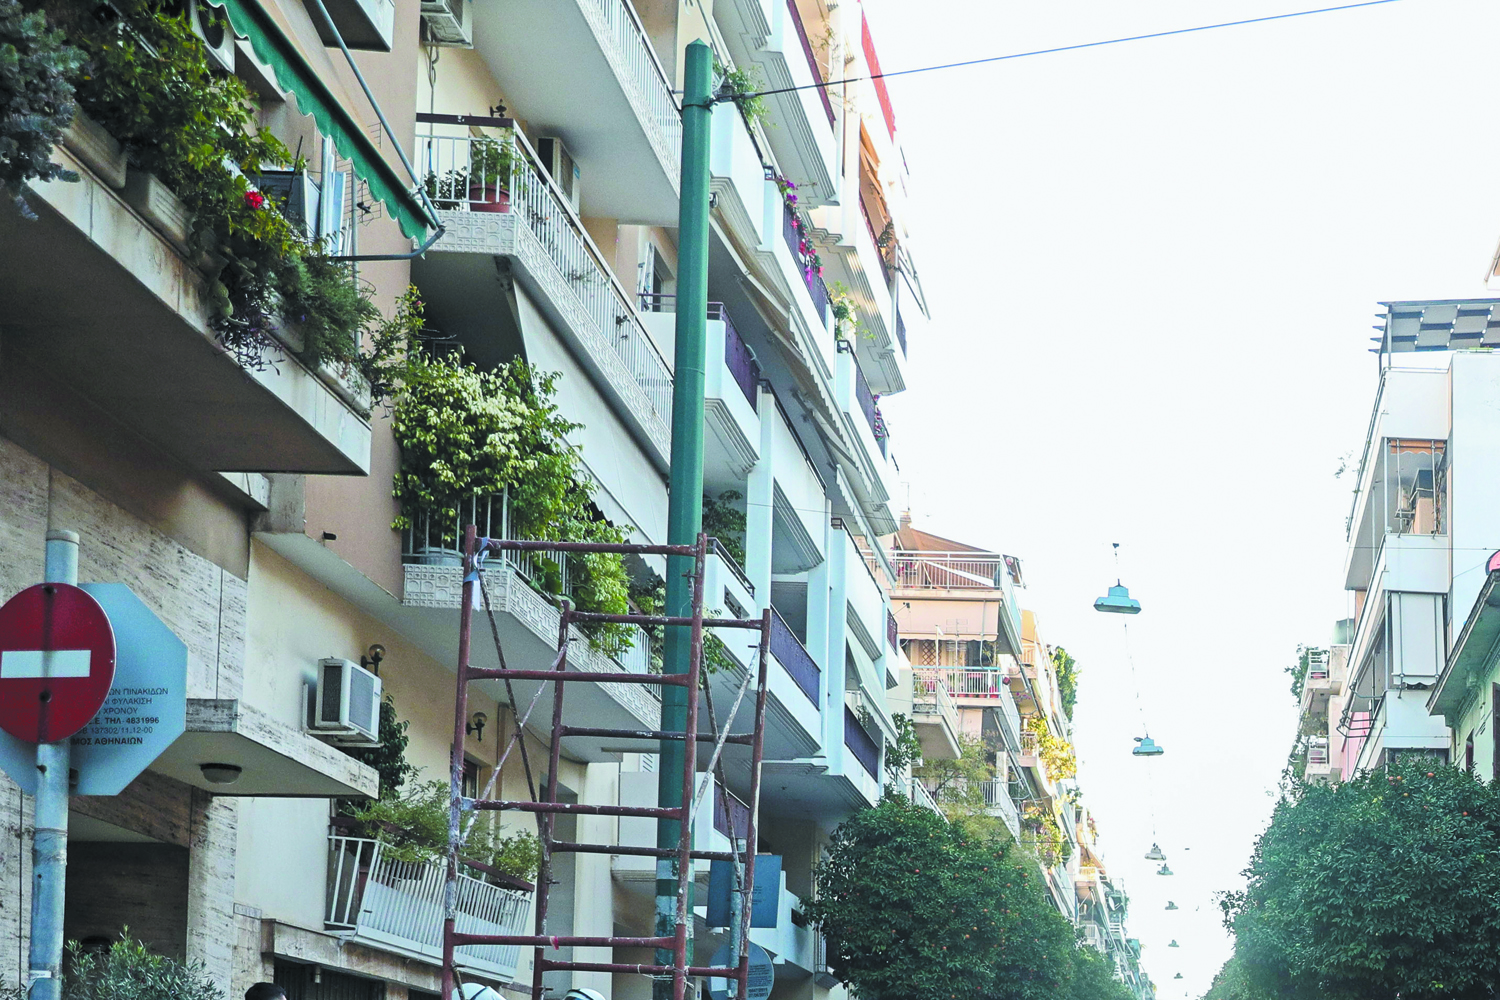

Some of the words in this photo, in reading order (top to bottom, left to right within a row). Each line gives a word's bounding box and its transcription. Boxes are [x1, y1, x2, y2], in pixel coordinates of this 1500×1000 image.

[123, 687, 169, 696] ΠΙΝΑΚΙΔΩΝ
[111, 697, 153, 705] ΦΥΛΑΚΙΣΗ
[103, 707, 138, 715] ΧΡΟΝΟΥ
[94, 737, 143, 746] ΑΘΗΝΑΙΩΝ
